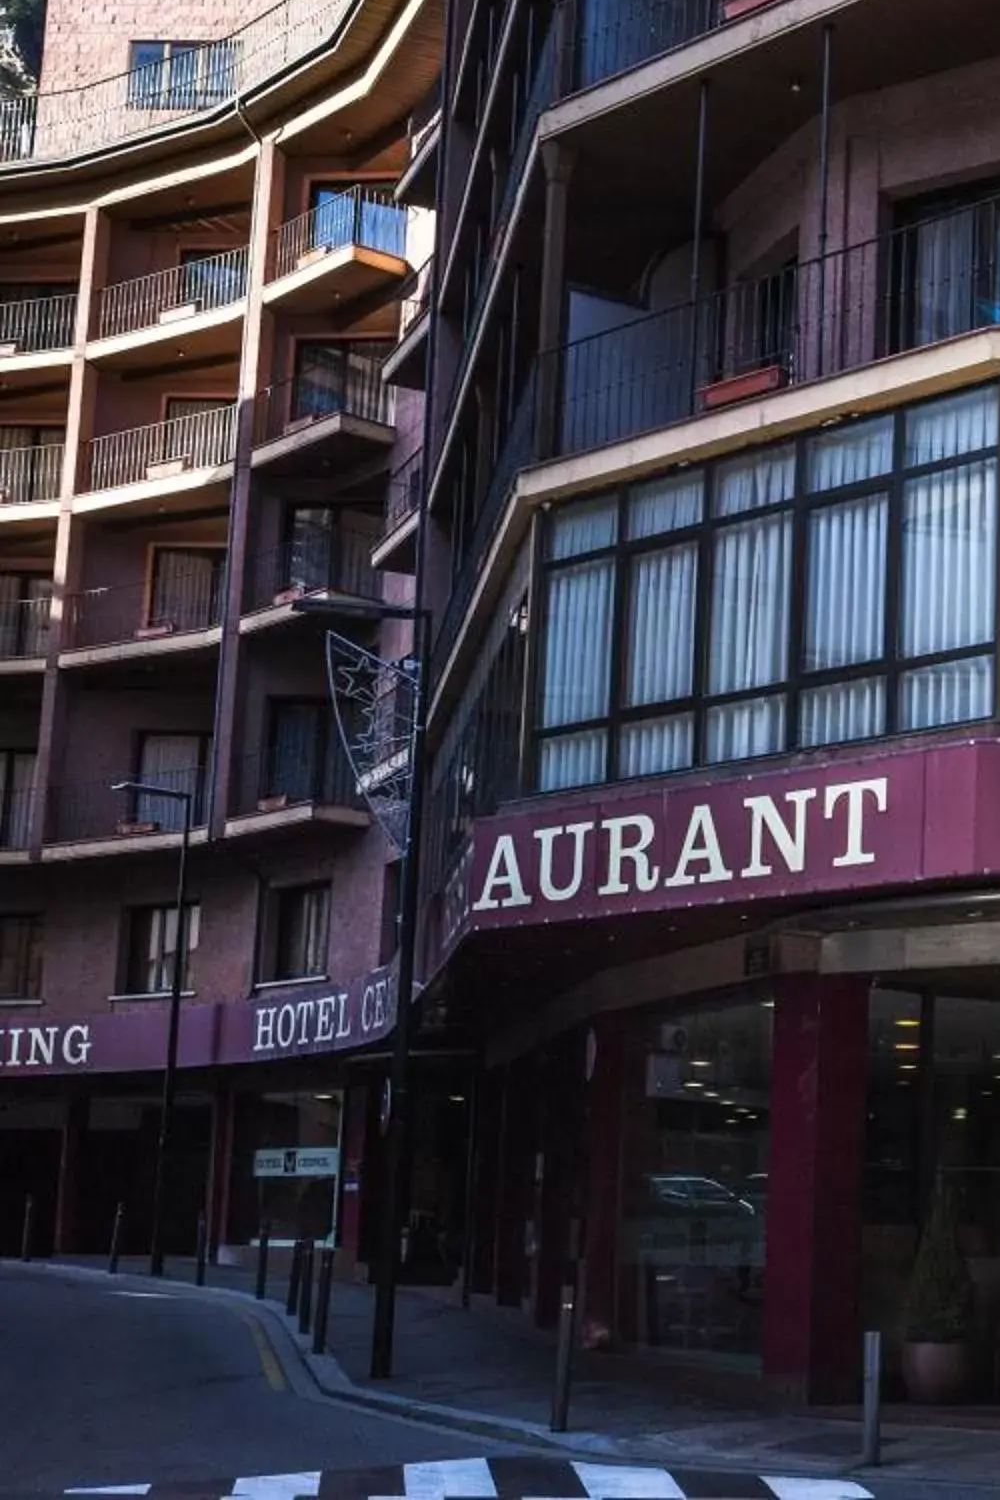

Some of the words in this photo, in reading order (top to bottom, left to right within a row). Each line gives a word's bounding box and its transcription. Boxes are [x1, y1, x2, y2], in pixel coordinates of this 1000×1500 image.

[473, 776, 889, 911] AURANT
[0, 1024, 93, 1067] ING
[253, 992, 352, 1052] HOTEL
